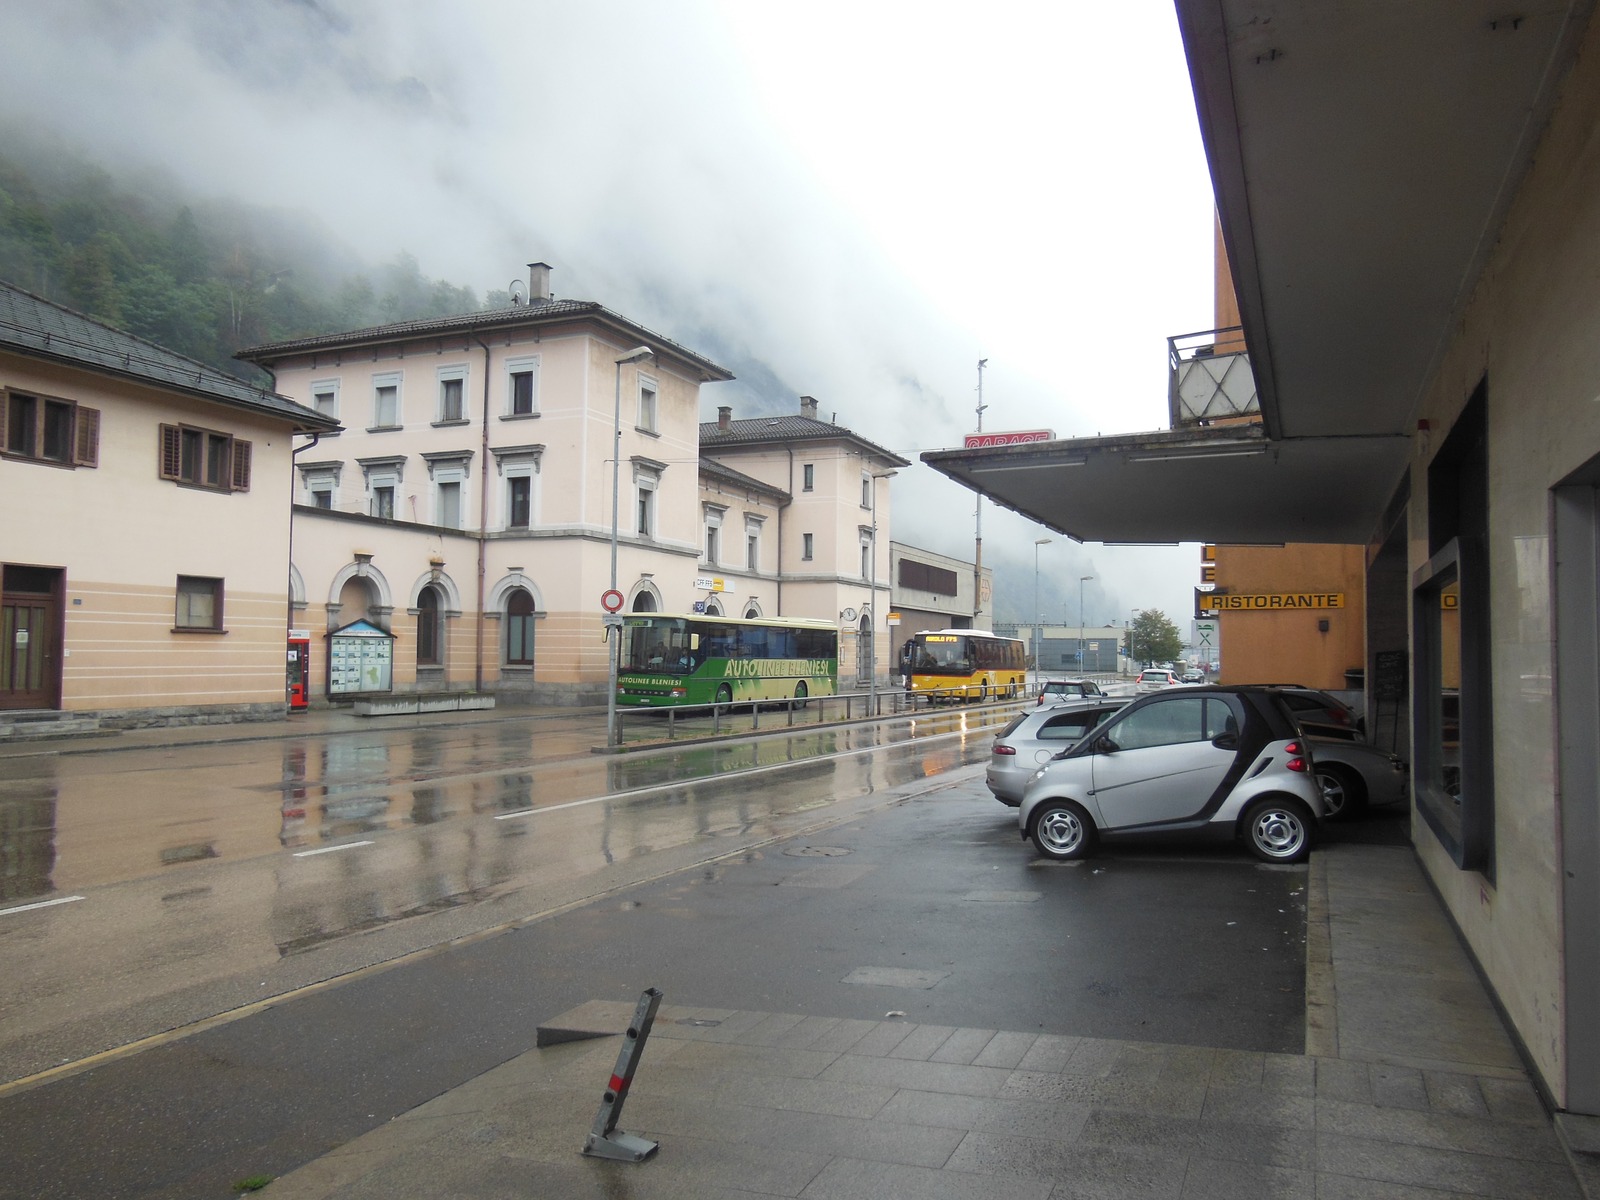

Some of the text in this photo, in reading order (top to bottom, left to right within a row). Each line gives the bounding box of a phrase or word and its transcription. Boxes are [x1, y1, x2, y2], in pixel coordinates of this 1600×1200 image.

[1211, 593, 1339, 609] RISTORANTE
[724, 658, 829, 677] AUTOLINEE BLENIESI
[651, 678, 682, 686] BLENIESI
